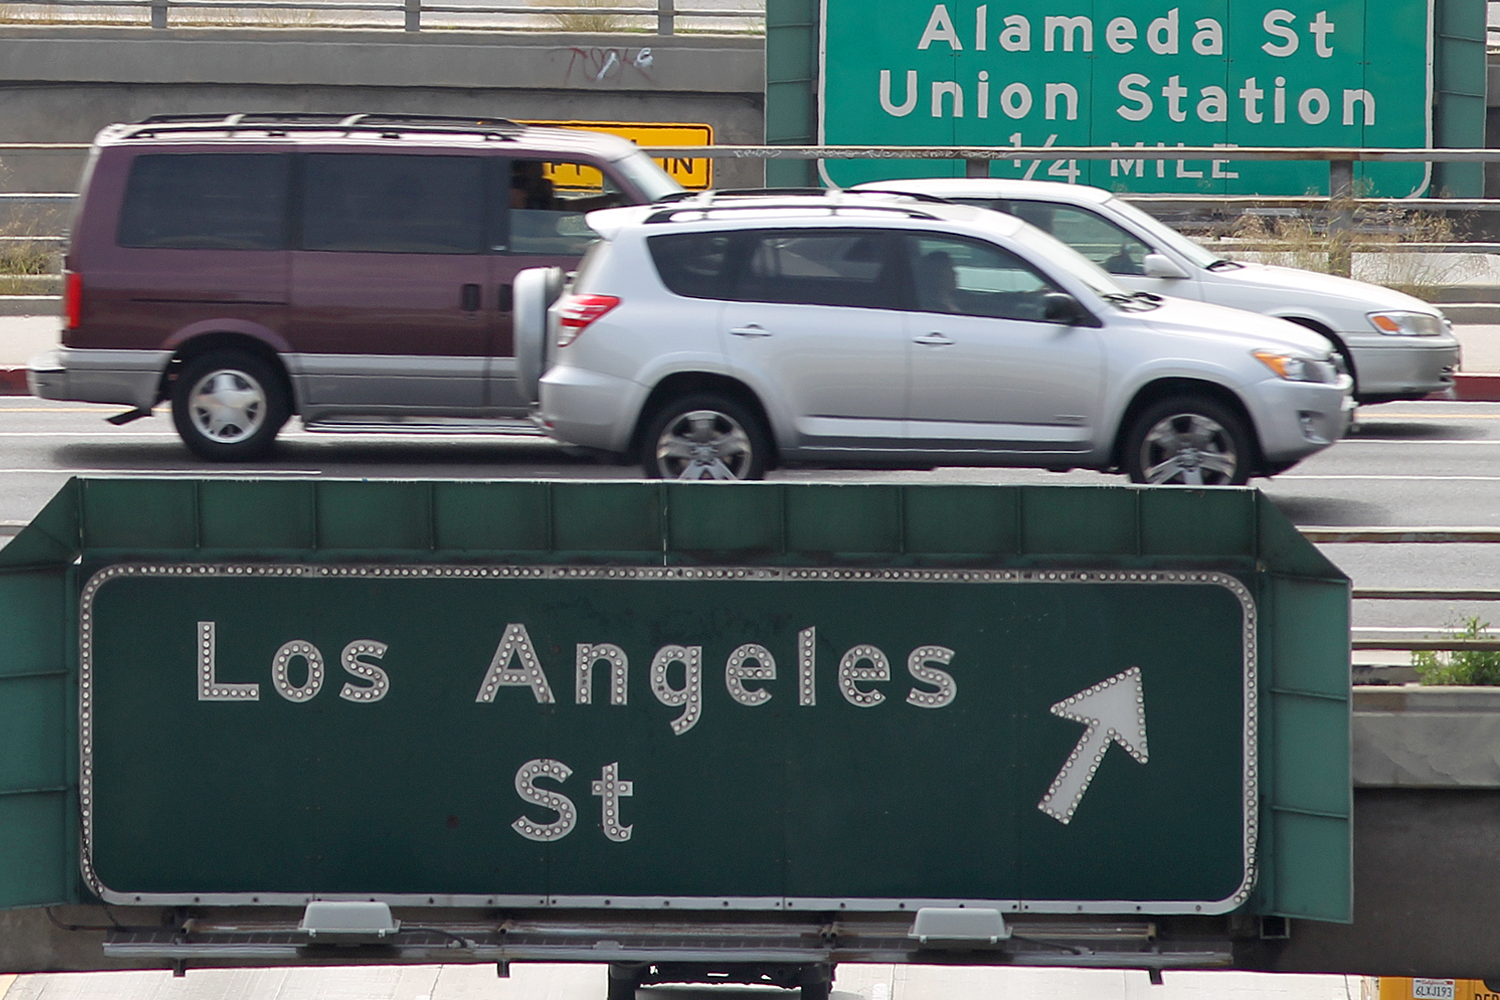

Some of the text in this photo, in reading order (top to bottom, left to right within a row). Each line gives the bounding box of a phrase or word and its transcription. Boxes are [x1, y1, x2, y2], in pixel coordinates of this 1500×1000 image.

[917, 4, 1335, 58] Alameda St
[879, 69, 1377, 126] Union Station
[1110, 141, 1239, 179] MILE
[197, 620, 958, 736] Los Angeles
[510, 758, 634, 842] St
